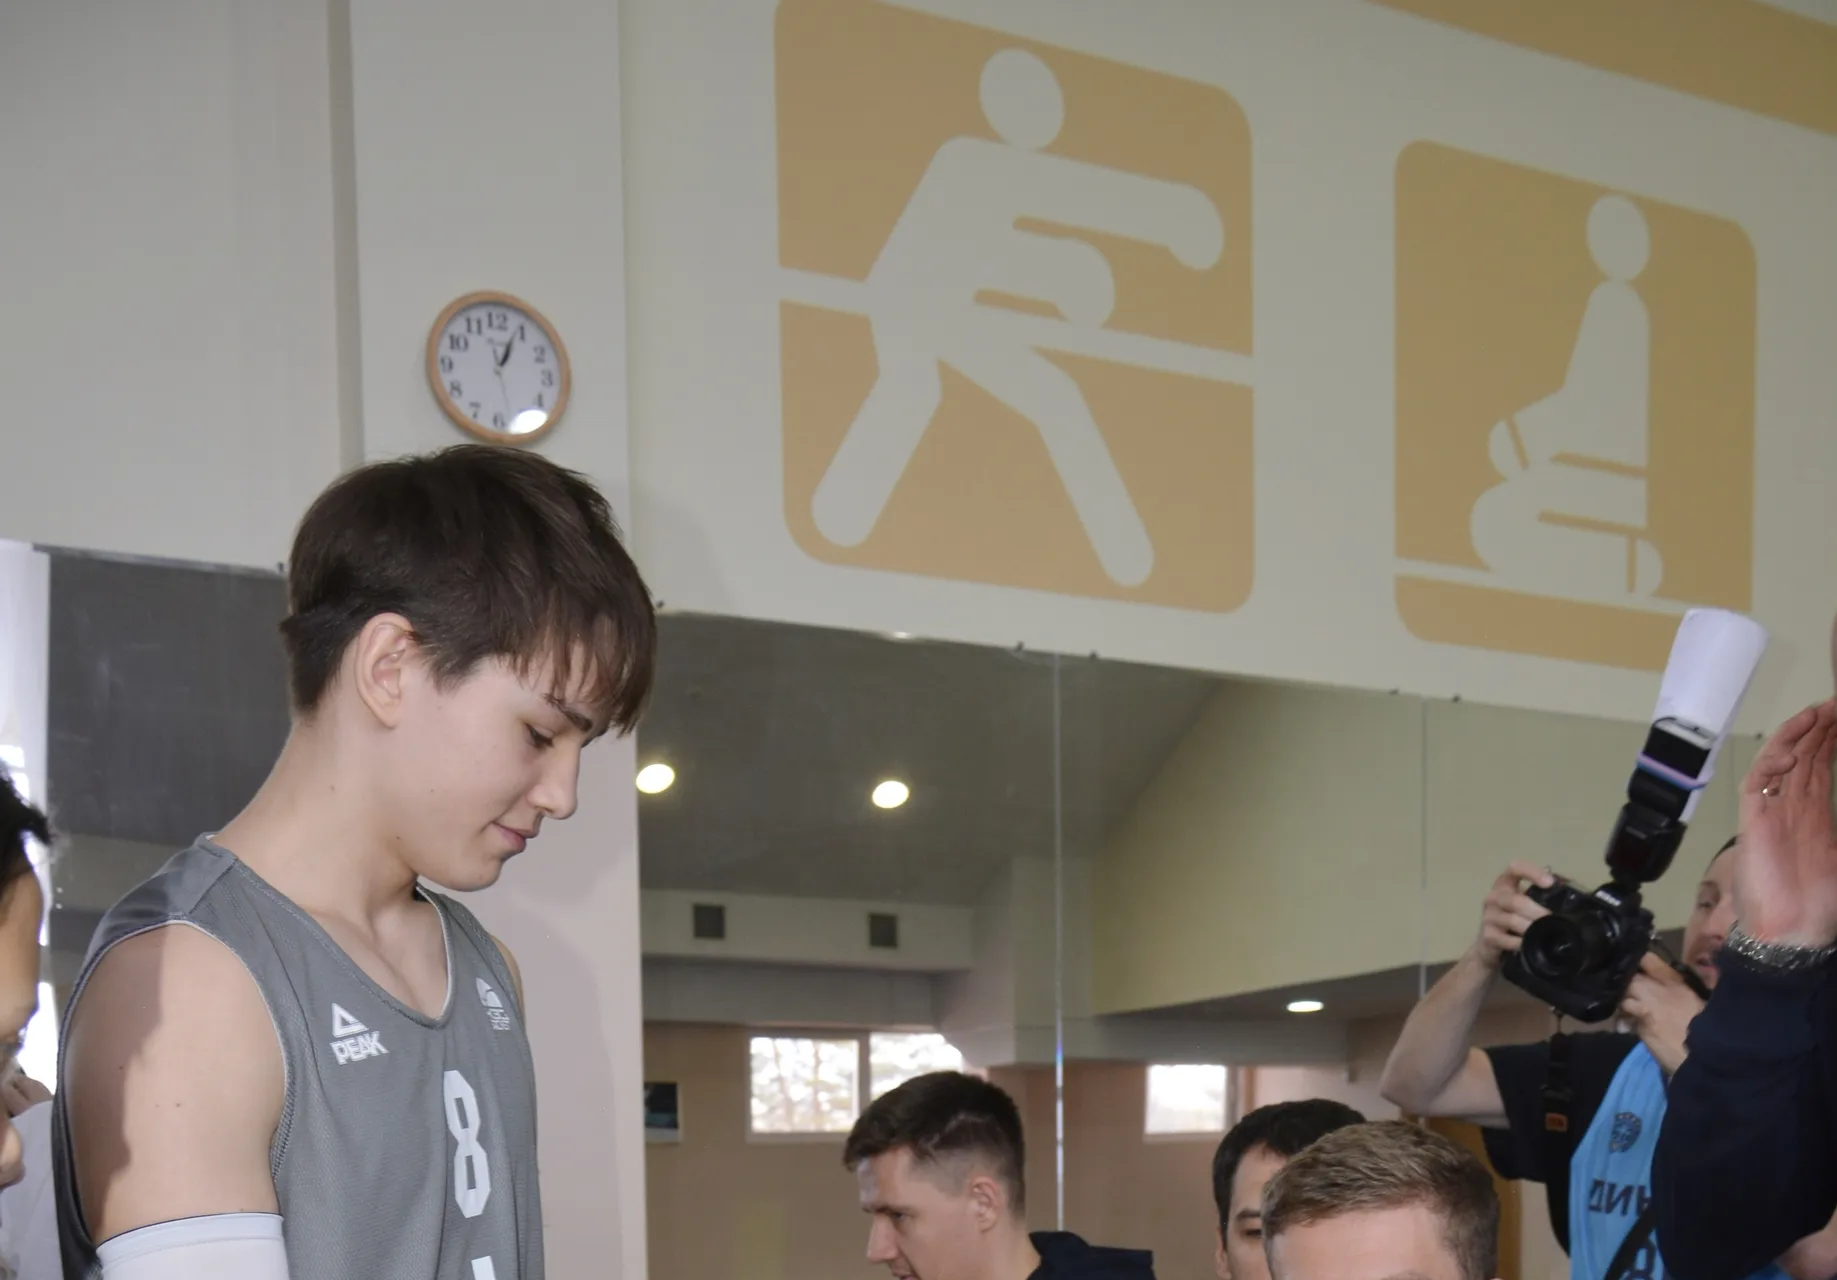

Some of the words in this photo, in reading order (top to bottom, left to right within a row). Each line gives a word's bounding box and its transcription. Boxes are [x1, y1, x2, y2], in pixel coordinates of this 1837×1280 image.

[465, 317, 482, 335] 11
[487, 312, 508, 331] 12
[449, 334, 469, 352] 10
[534, 346, 546, 363] 2
[440, 356, 454, 372] 9
[541, 369, 554, 387] 3
[450, 380, 462, 397] 8
[469, 401, 481, 419] 7
[329, 1031, 389, 1065] PEAK
[443, 1070, 492, 1219] 8
[1588, 1178, 1652, 1217] ДИН
